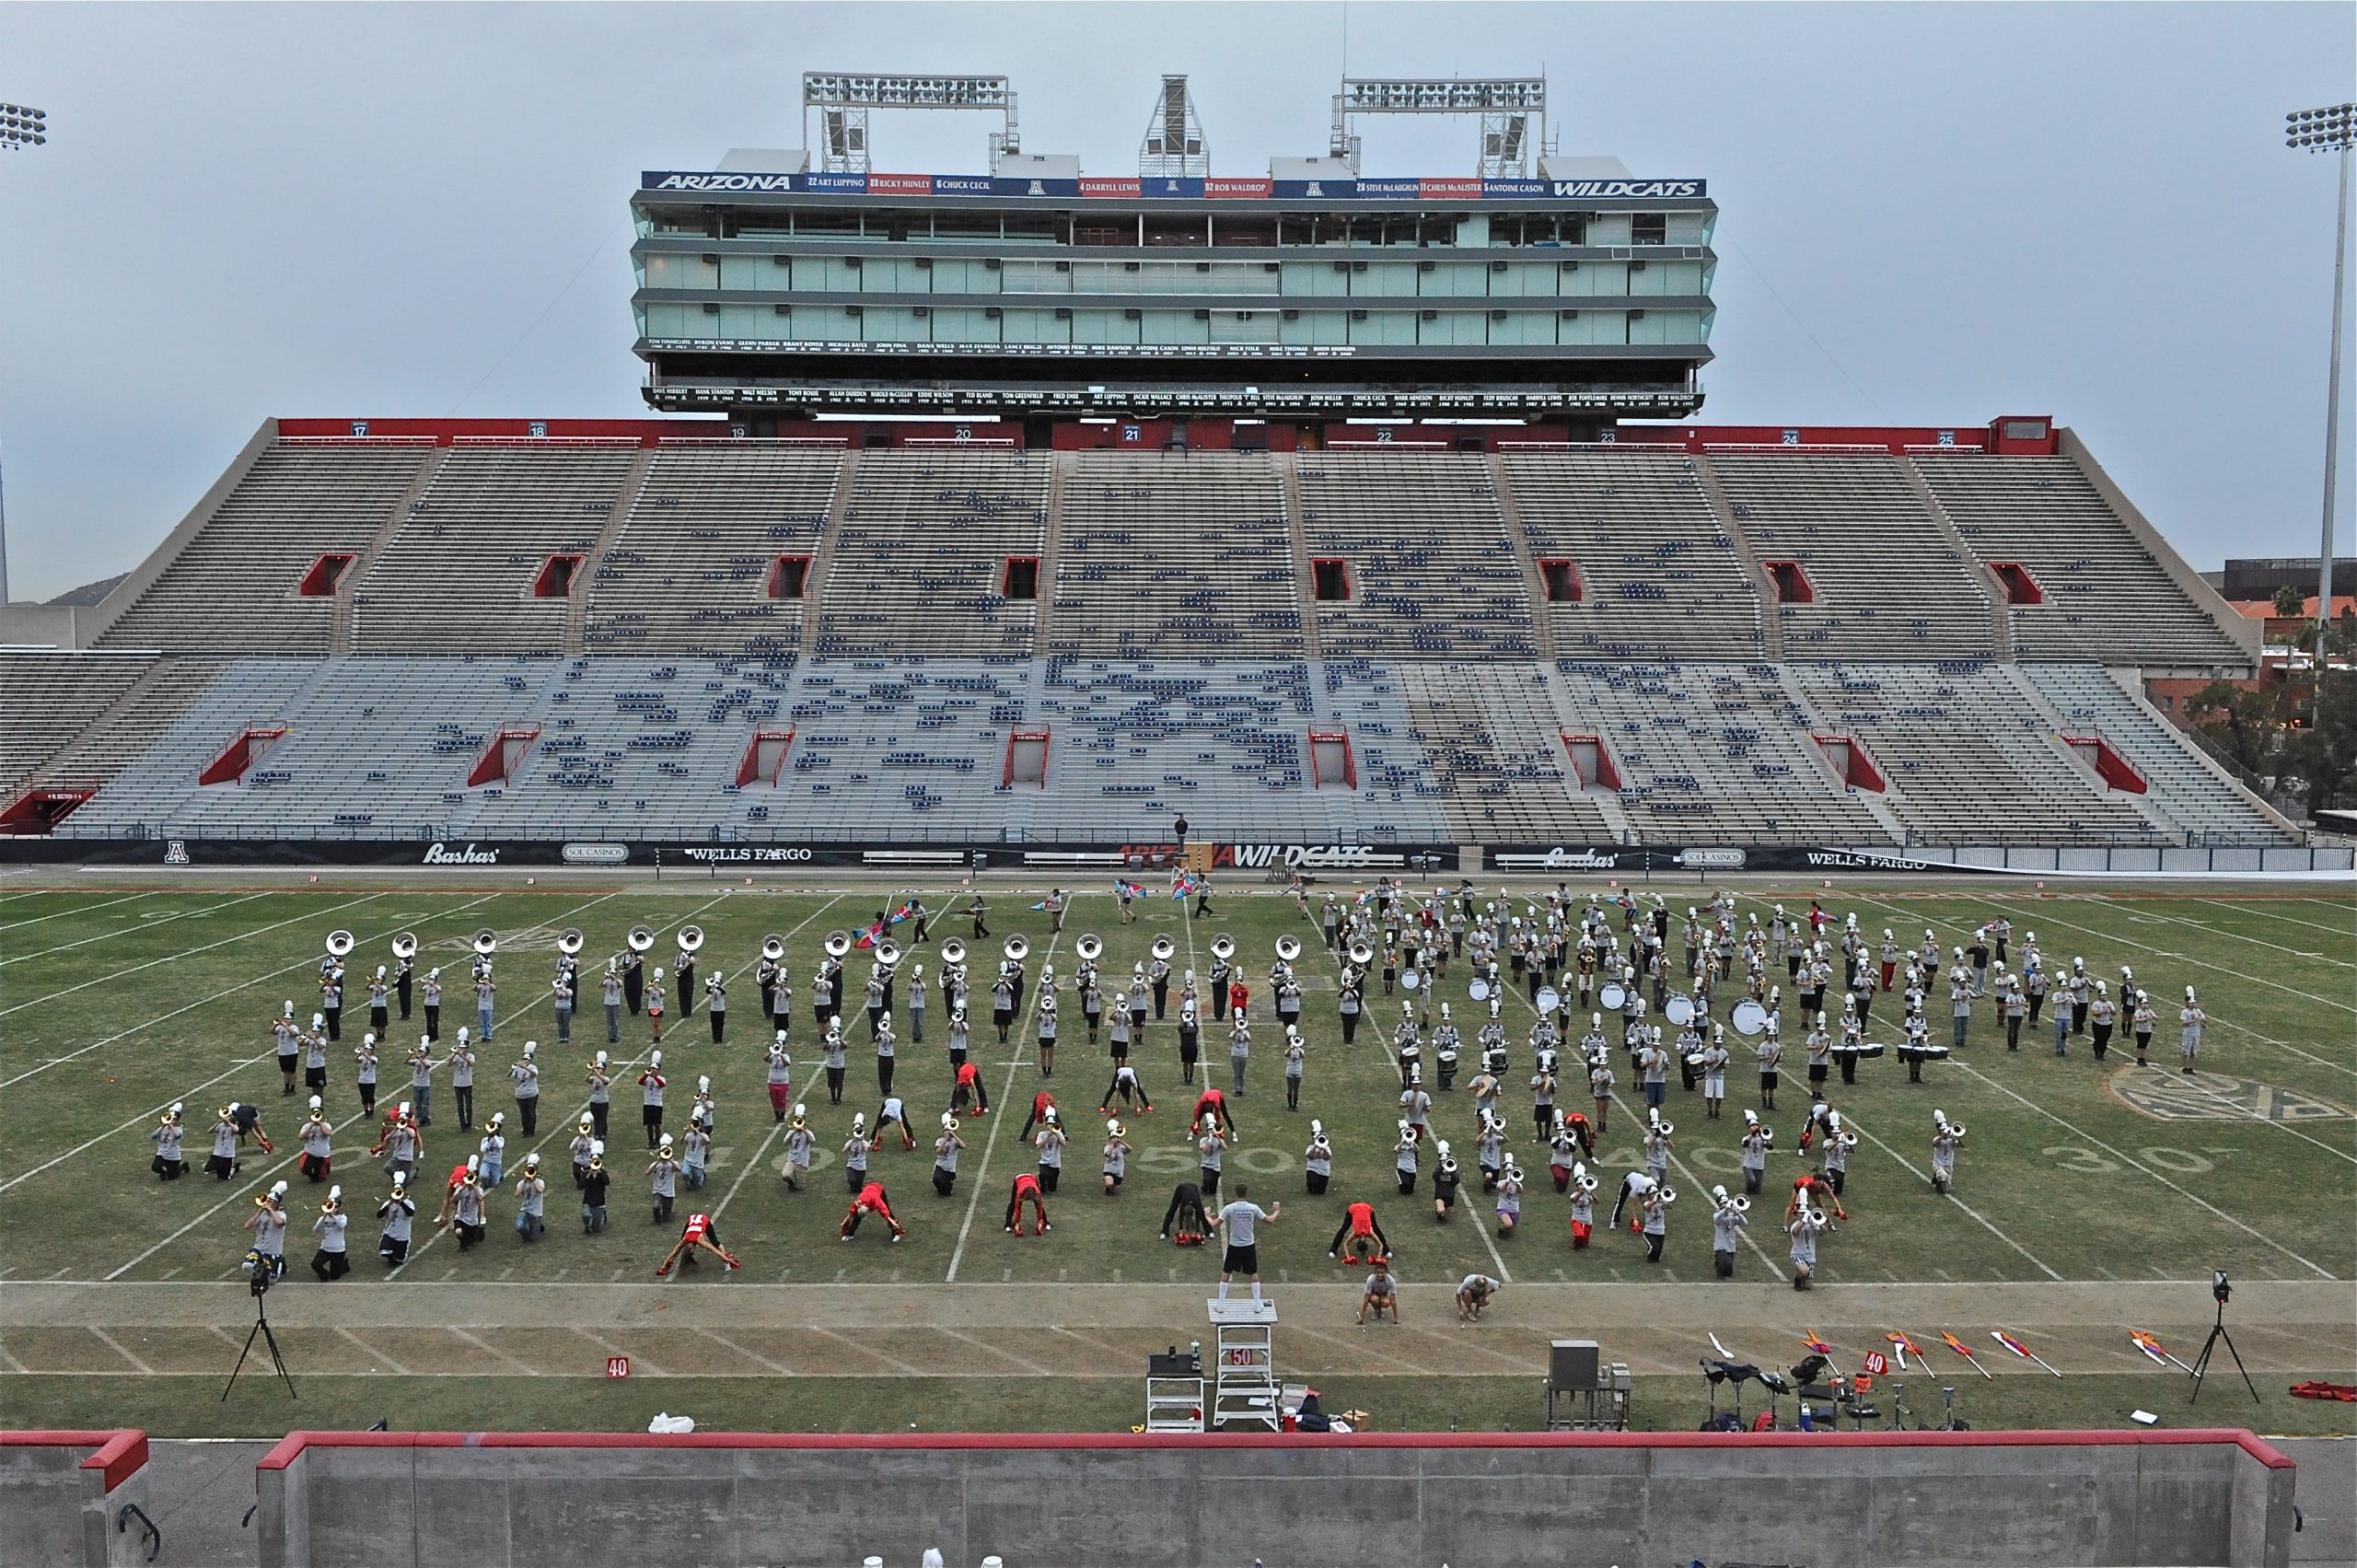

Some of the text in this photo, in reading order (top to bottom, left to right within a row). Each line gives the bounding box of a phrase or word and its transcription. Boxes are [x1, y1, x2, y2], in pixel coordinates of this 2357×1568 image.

[656, 175, 790, 190] ARIZONA
[808, 177, 865, 187] 22 ART LUPPINO
[870, 178, 930, 189] 89 RICKY HUNLEY
[936, 180, 990, 190] 6 CHUCK CECIL
[1079, 181, 1140, 192] 4 DARRYLL LEWIS
[1204, 182, 1265, 192] 92 ROB WALDROP
[1356, 182, 1419, 192] 28 STEVE McLAUGHLIN
[1420, 182, 1481, 192] 11 CHRIS McALISTER
[1028, 180, 1044, 195] A
[1306, 181, 1322, 197] A
[1484, 183, 1544, 192] 5 ANTOINE CASON
[1553, 181, 1698, 197] WILDCATS
[354, 426, 366, 436] 17
[531, 426, 544, 436] 18
[731, 428, 745, 438] 19
[956, 429, 970, 439] 20
[1125, 430, 1138, 440] 21
[1377, 432, 1392, 442] 22
[1601, 433, 1615, 443] 23
[1782, 435, 1798, 445] 24
[1939, 436, 1954, 446] 25
[164, 840, 189, 864] A
[422, 842, 500, 864] Bashas'
[569, 848, 622, 856] SOL CASINOS
[692, 848, 812, 860] WELLS FARGO
[1807, 853, 1866, 866] WELLS
[1135, 1145, 1295, 1174] 50
[2041, 1146, 2216, 1173] 30
[1233, 1349, 1251, 1365] 50
[609, 1359, 627, 1376] 40
[1866, 1353, 1884, 1373] 40
